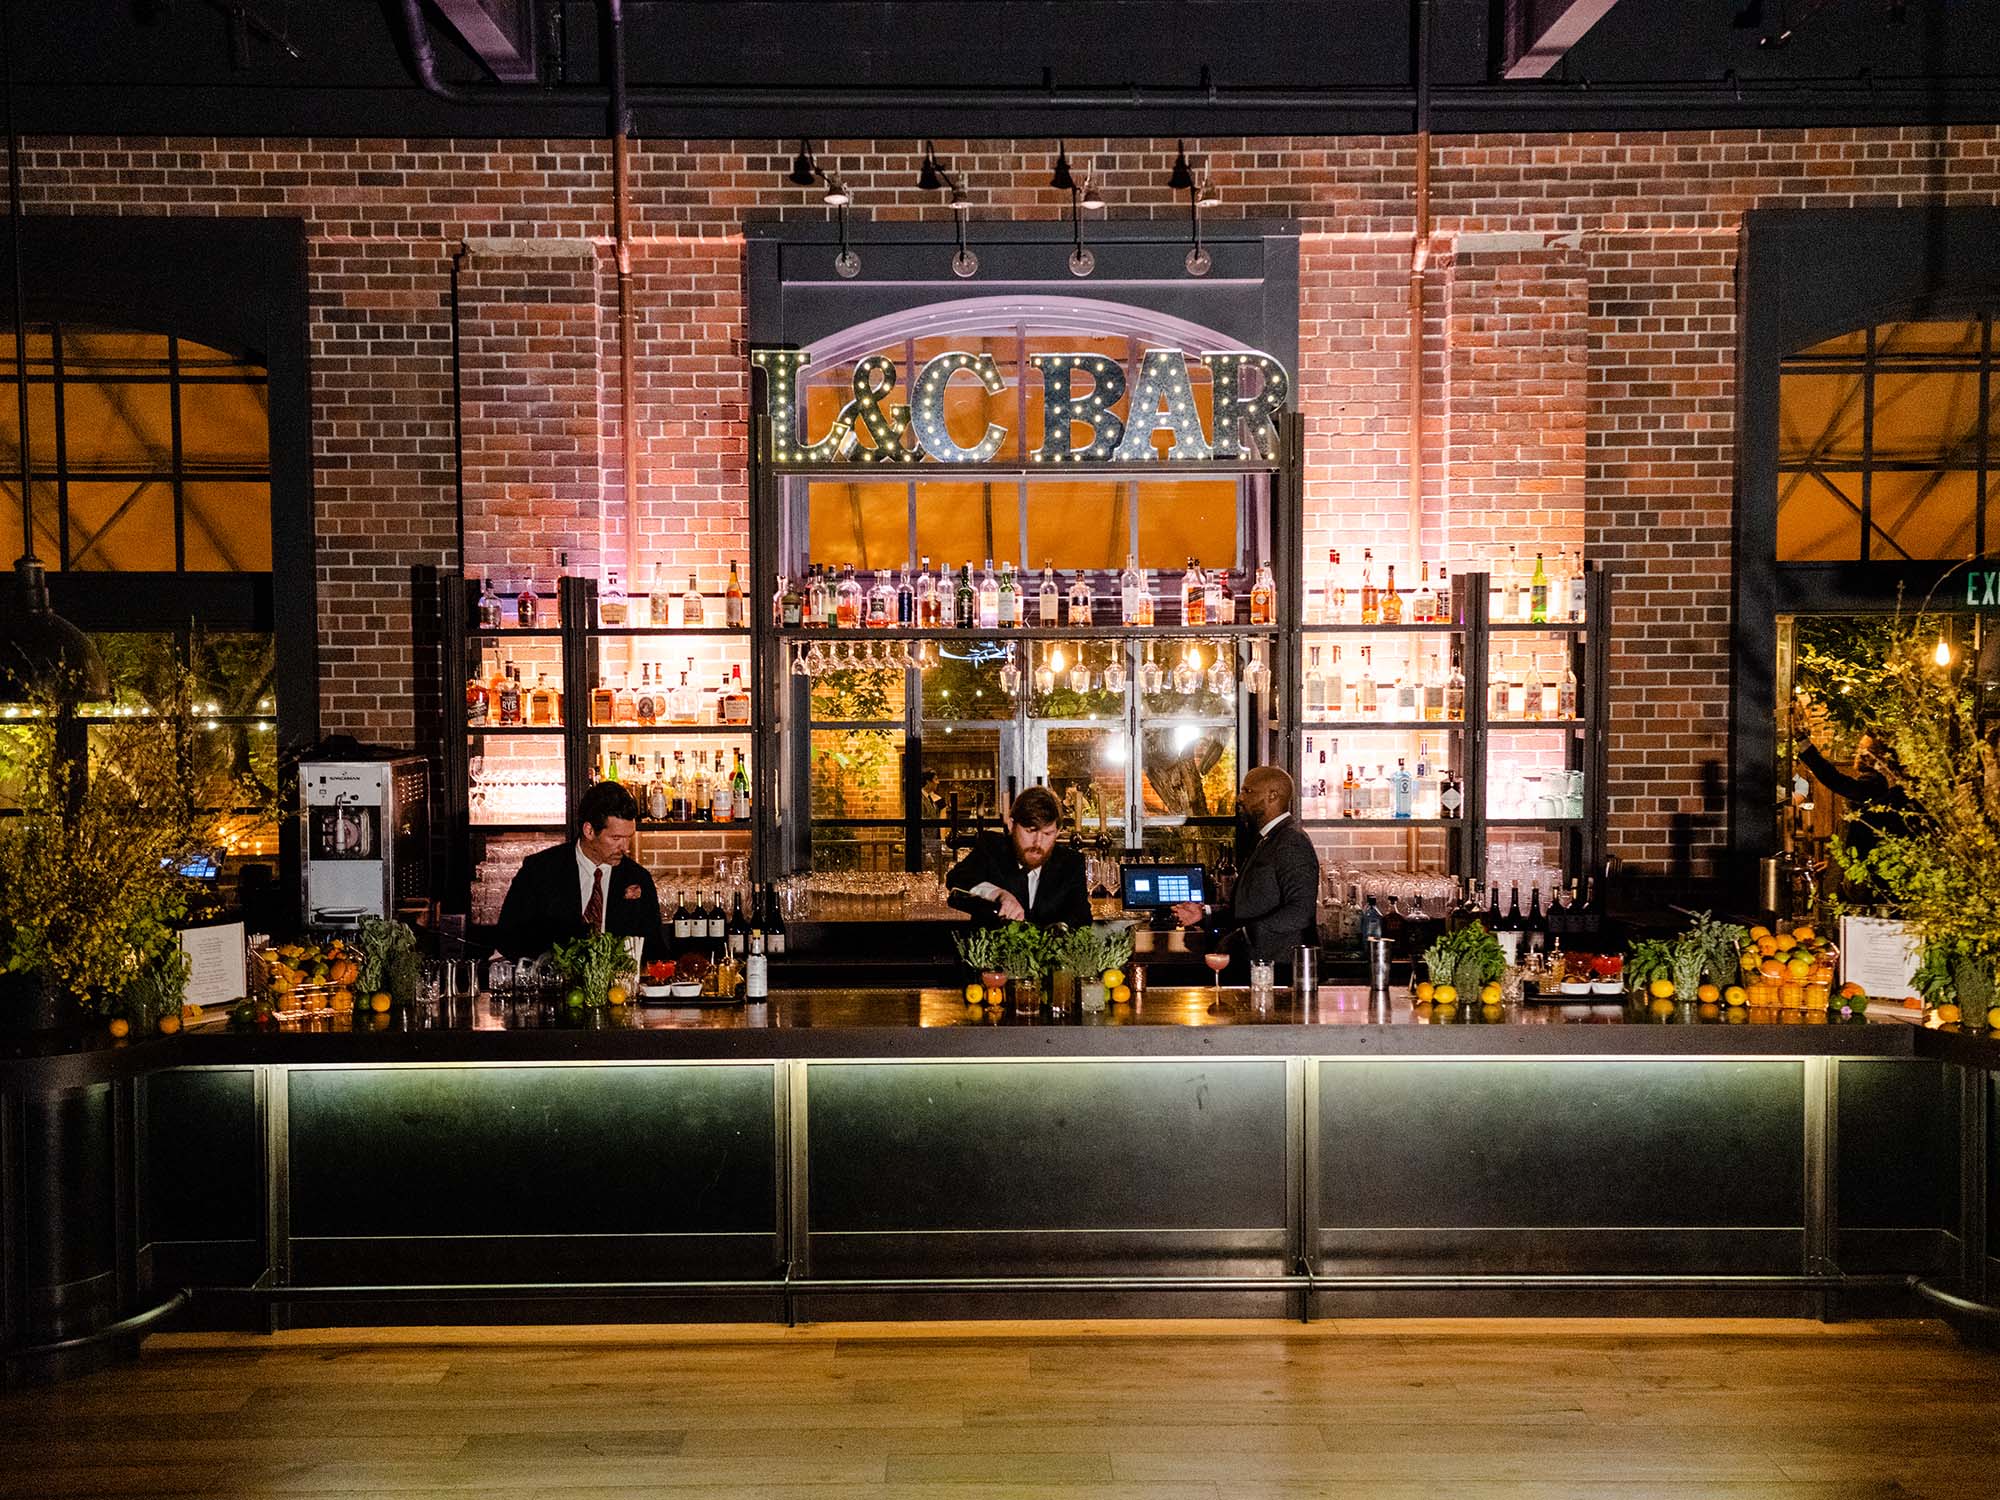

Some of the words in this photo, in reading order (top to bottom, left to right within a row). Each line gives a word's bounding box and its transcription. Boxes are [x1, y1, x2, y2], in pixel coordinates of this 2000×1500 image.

[751, 349, 1007, 463] L&C
[1029, 348, 1288, 463] BAR
[502, 700, 518, 710] RYE
